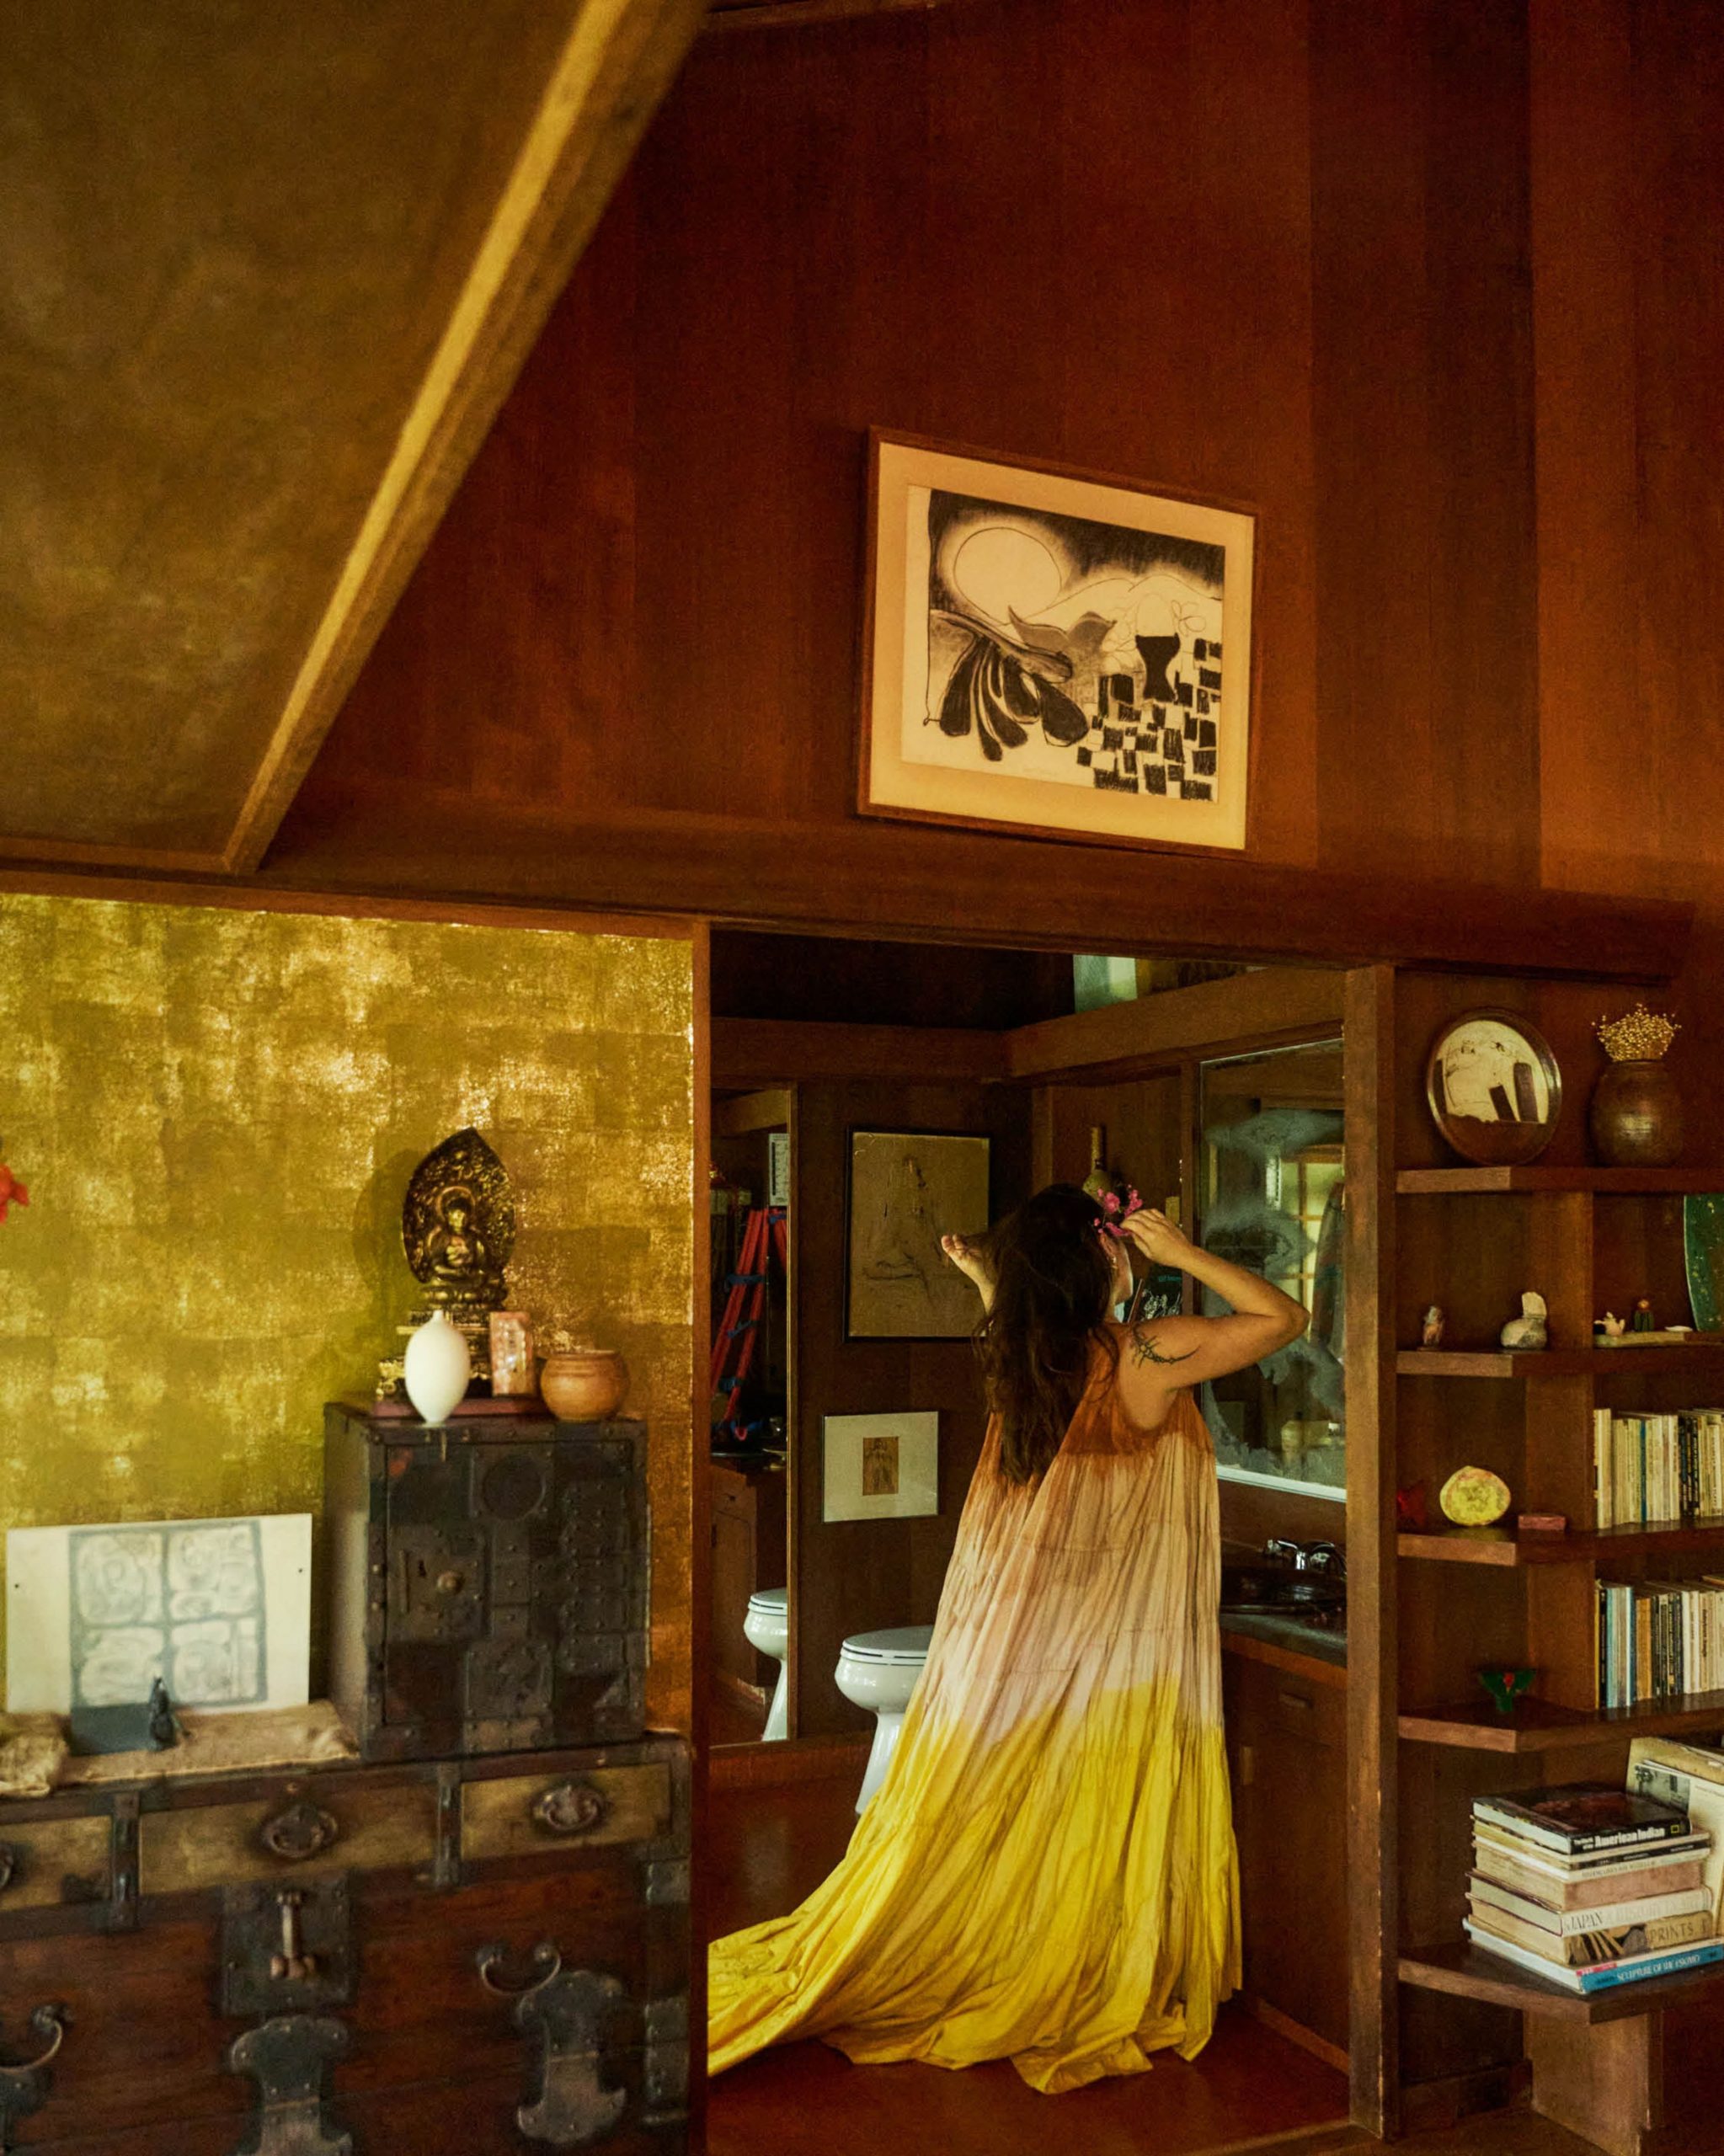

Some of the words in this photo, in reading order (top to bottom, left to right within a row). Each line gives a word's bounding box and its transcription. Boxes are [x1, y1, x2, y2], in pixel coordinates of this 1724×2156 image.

[1594, 1831, 1637, 1848] American
[1637, 1827, 1665, 1841] Indian
[1571, 1912, 1603, 1930] JAPAN
[1650, 1922, 1694, 1942] PRINTS
